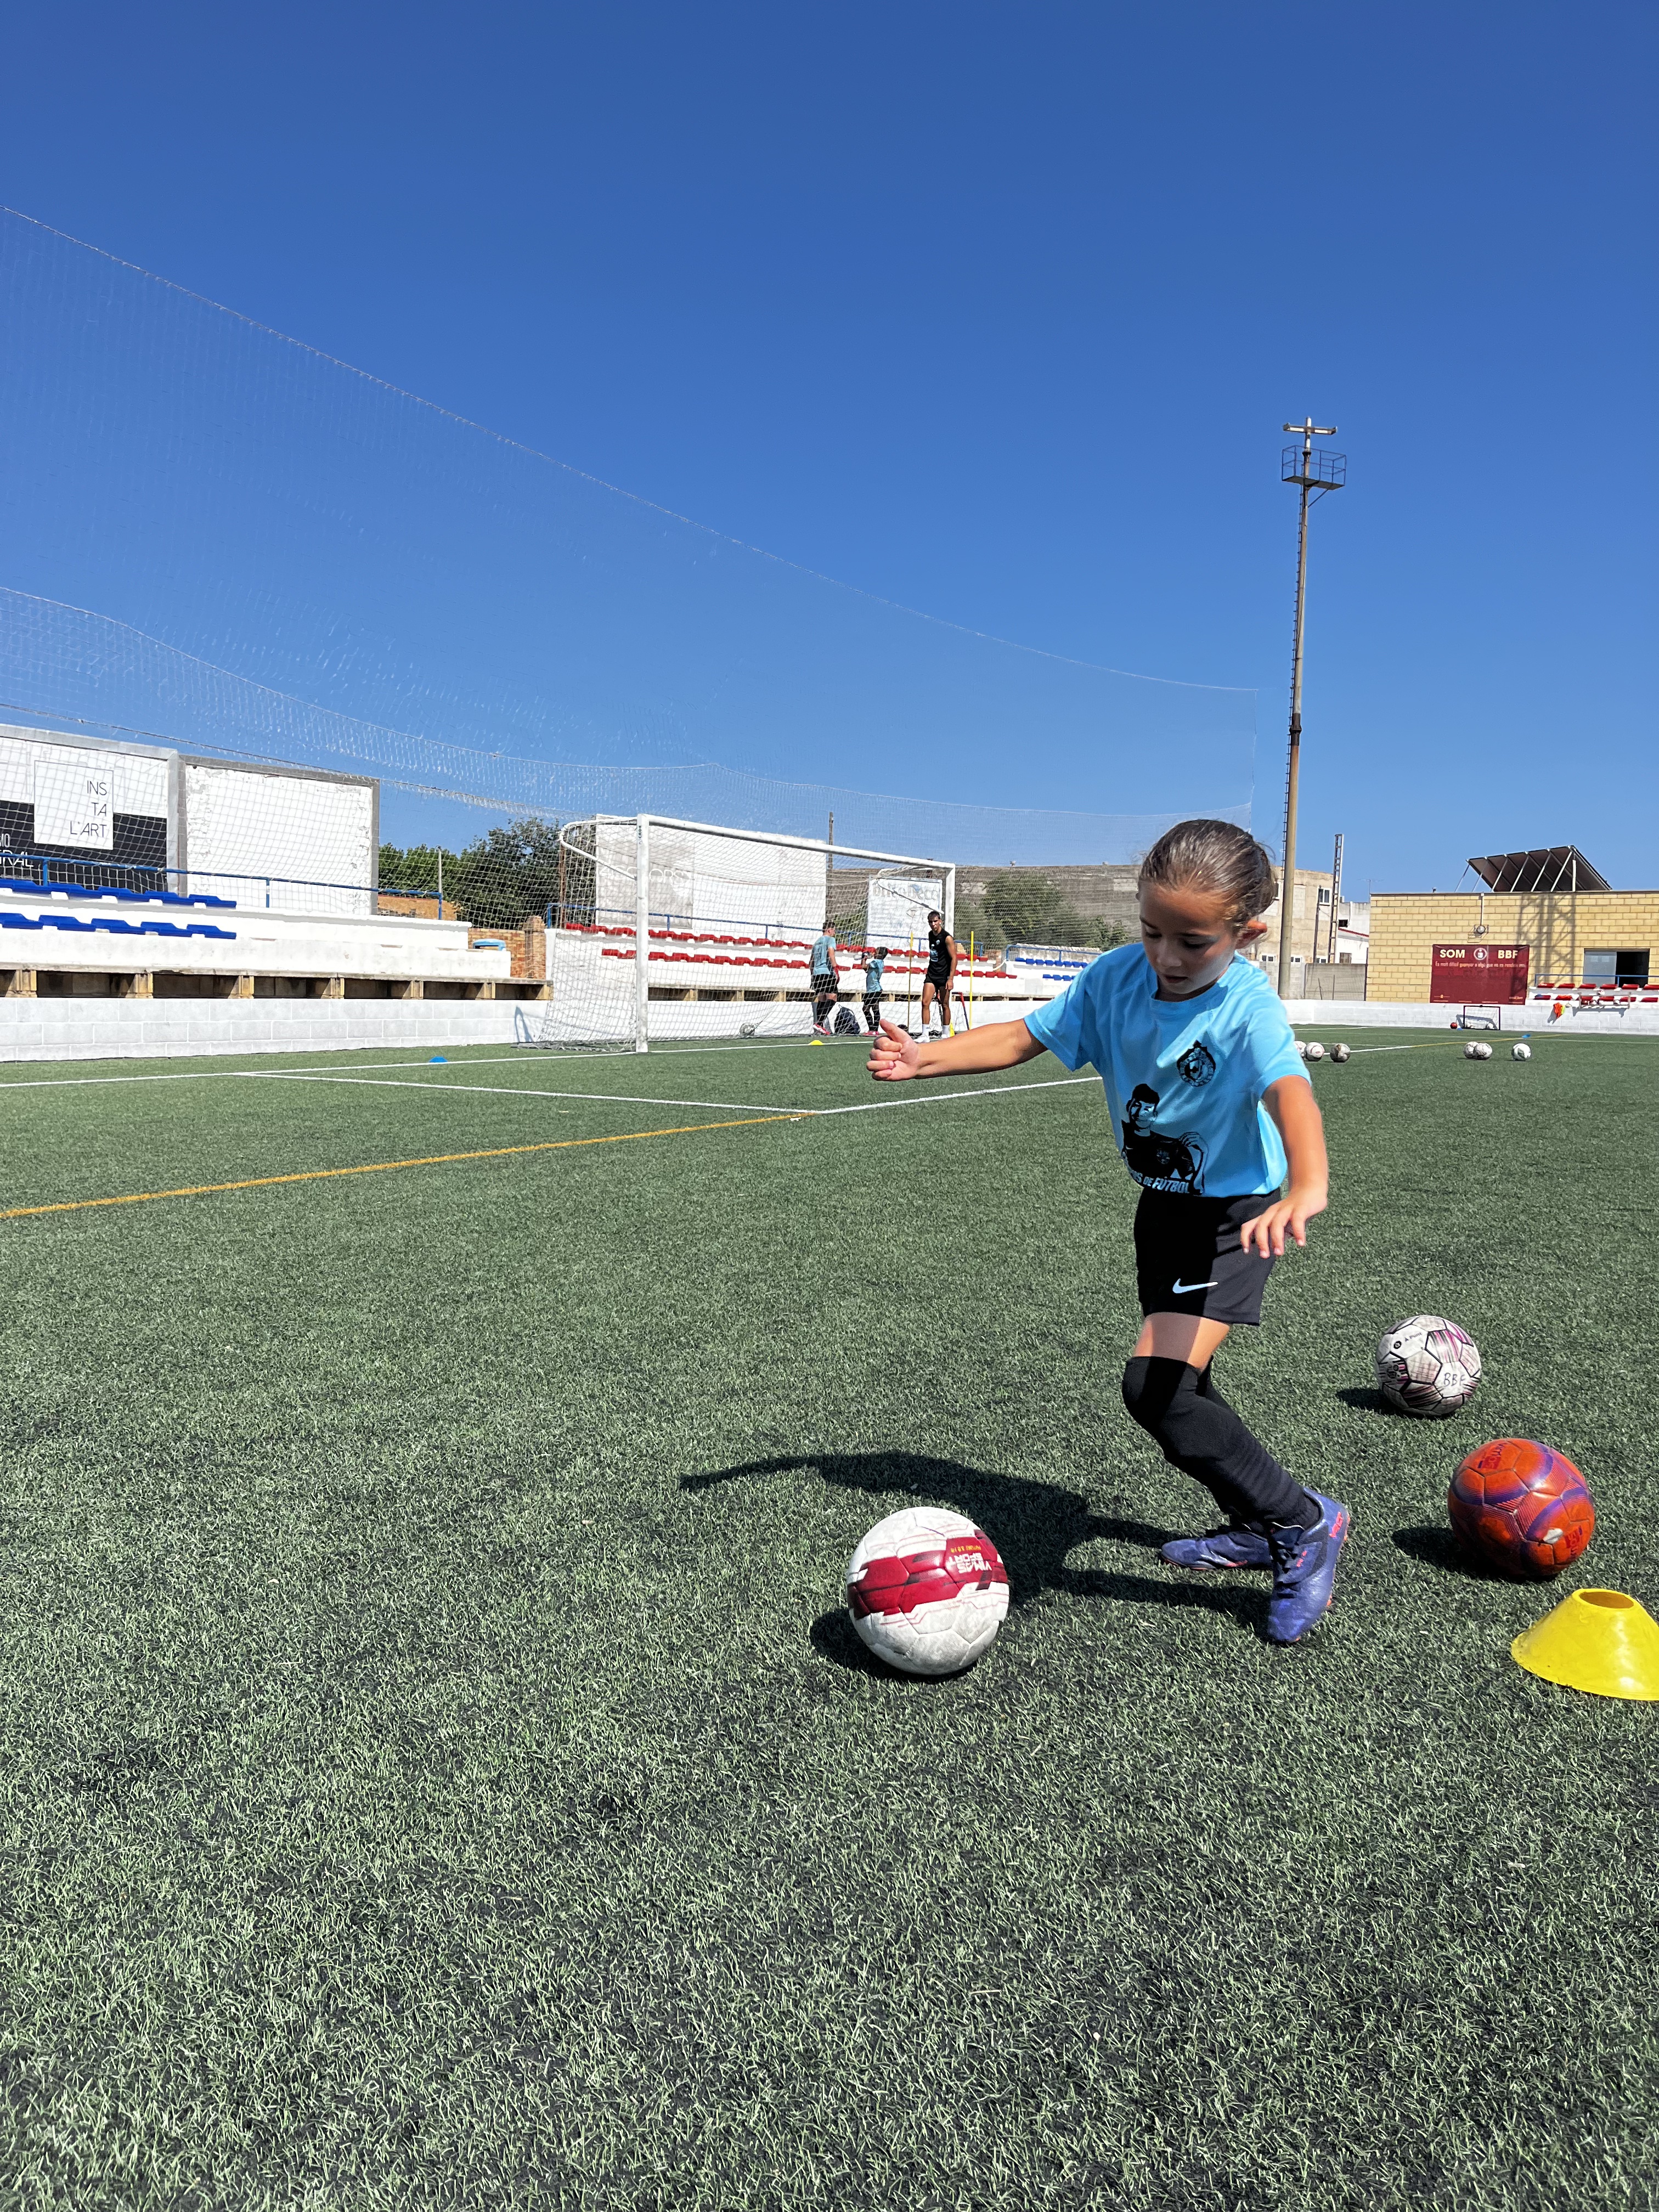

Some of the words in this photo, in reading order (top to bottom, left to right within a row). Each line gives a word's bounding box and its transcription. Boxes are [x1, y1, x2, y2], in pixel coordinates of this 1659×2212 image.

[87, 780, 107, 795] INS
[91, 802, 107, 816] TA
[1440, 949, 1465, 958] SOM
[1498, 950, 1518, 959] BBF
[1152, 1176, 1190, 1194] FÚTBOL
[1443, 1372, 1466, 1387] BBF
[946, 1552, 984, 1565] SPORT
[956, 1560, 992, 1574] VIMAS
